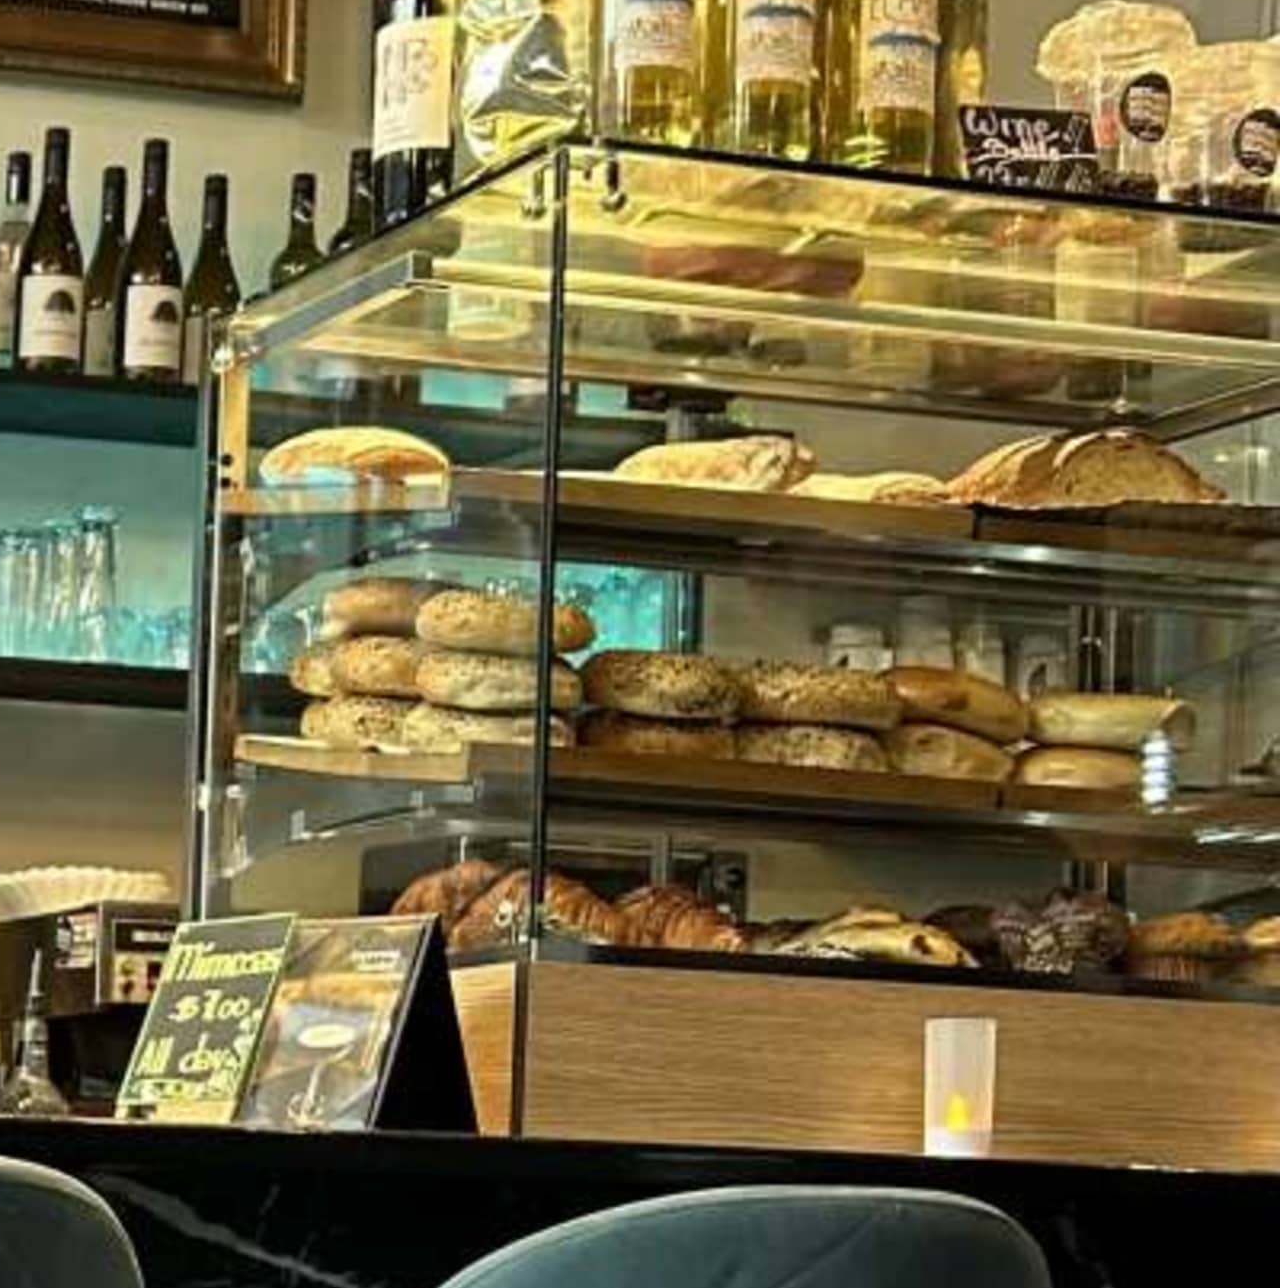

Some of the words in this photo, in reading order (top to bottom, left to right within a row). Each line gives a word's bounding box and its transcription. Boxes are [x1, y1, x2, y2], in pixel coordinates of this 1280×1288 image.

[965, 107, 1059, 137] Wine
[164, 941, 283, 981] Mimosas
[137, 1035, 175, 1076] All
